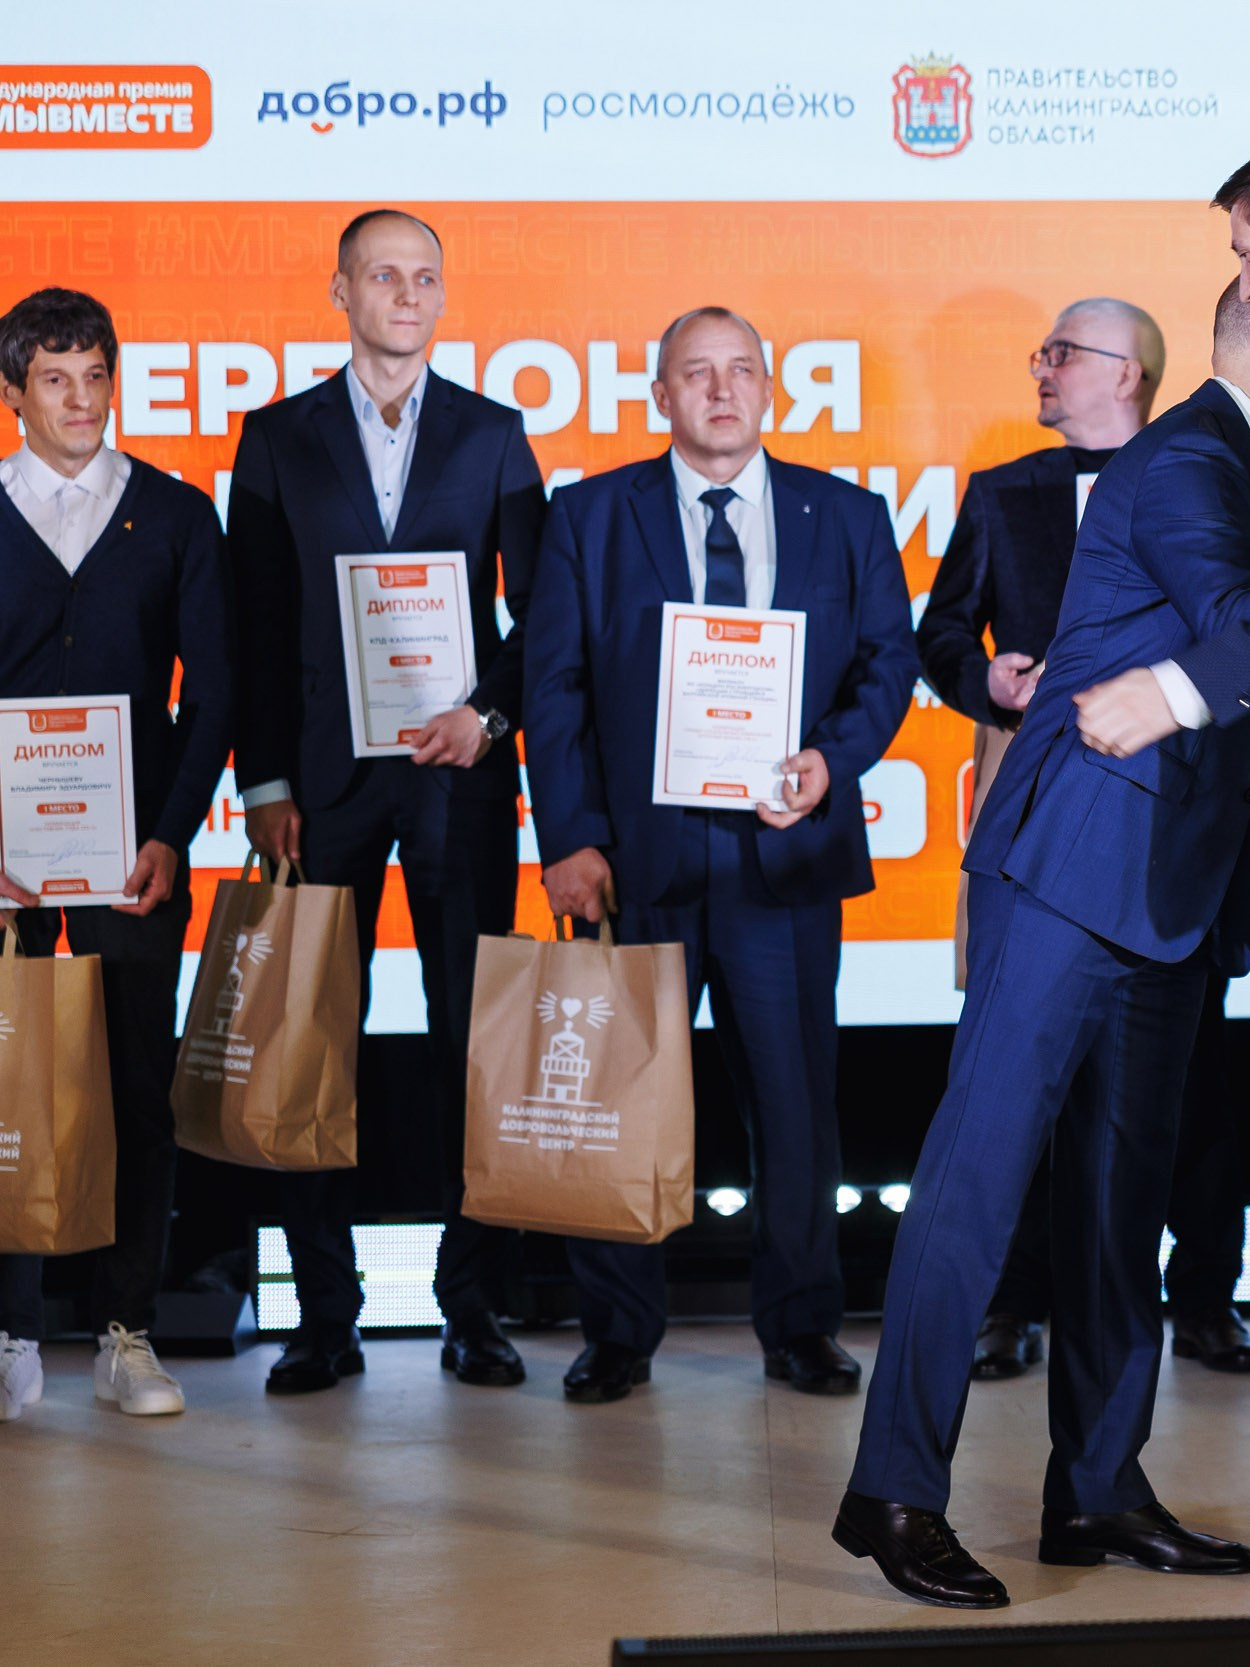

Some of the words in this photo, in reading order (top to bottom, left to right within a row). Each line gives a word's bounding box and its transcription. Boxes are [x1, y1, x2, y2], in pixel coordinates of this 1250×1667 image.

[987, 68, 1178, 88] ПРАВИТЕЛЬСТВО
[118, 81, 193, 104] премия
[257, 79, 508, 127] добро.рф
[542, 83, 856, 133] росмолодёжь
[987, 94, 1218, 117] КАЛИНИНГРАДСКОЙ
[987, 125, 1096, 145] ОБЛАСТИ
[366, 598, 445, 616] ДИПЛОМ
[688, 651, 776, 669] ДИПЛОМ
[14, 743, 105, 762] ДИПЛОМ
[49, 804, 80, 813] МЕСТО
[502, 1103, 620, 1125] КАЛИНИНГРАДСКИЙ
[499, 1119, 620, 1140] ДОБРОВОЛЬЧЕСКИЙ
[538, 1137, 576, 1151] ЦЕНТР
